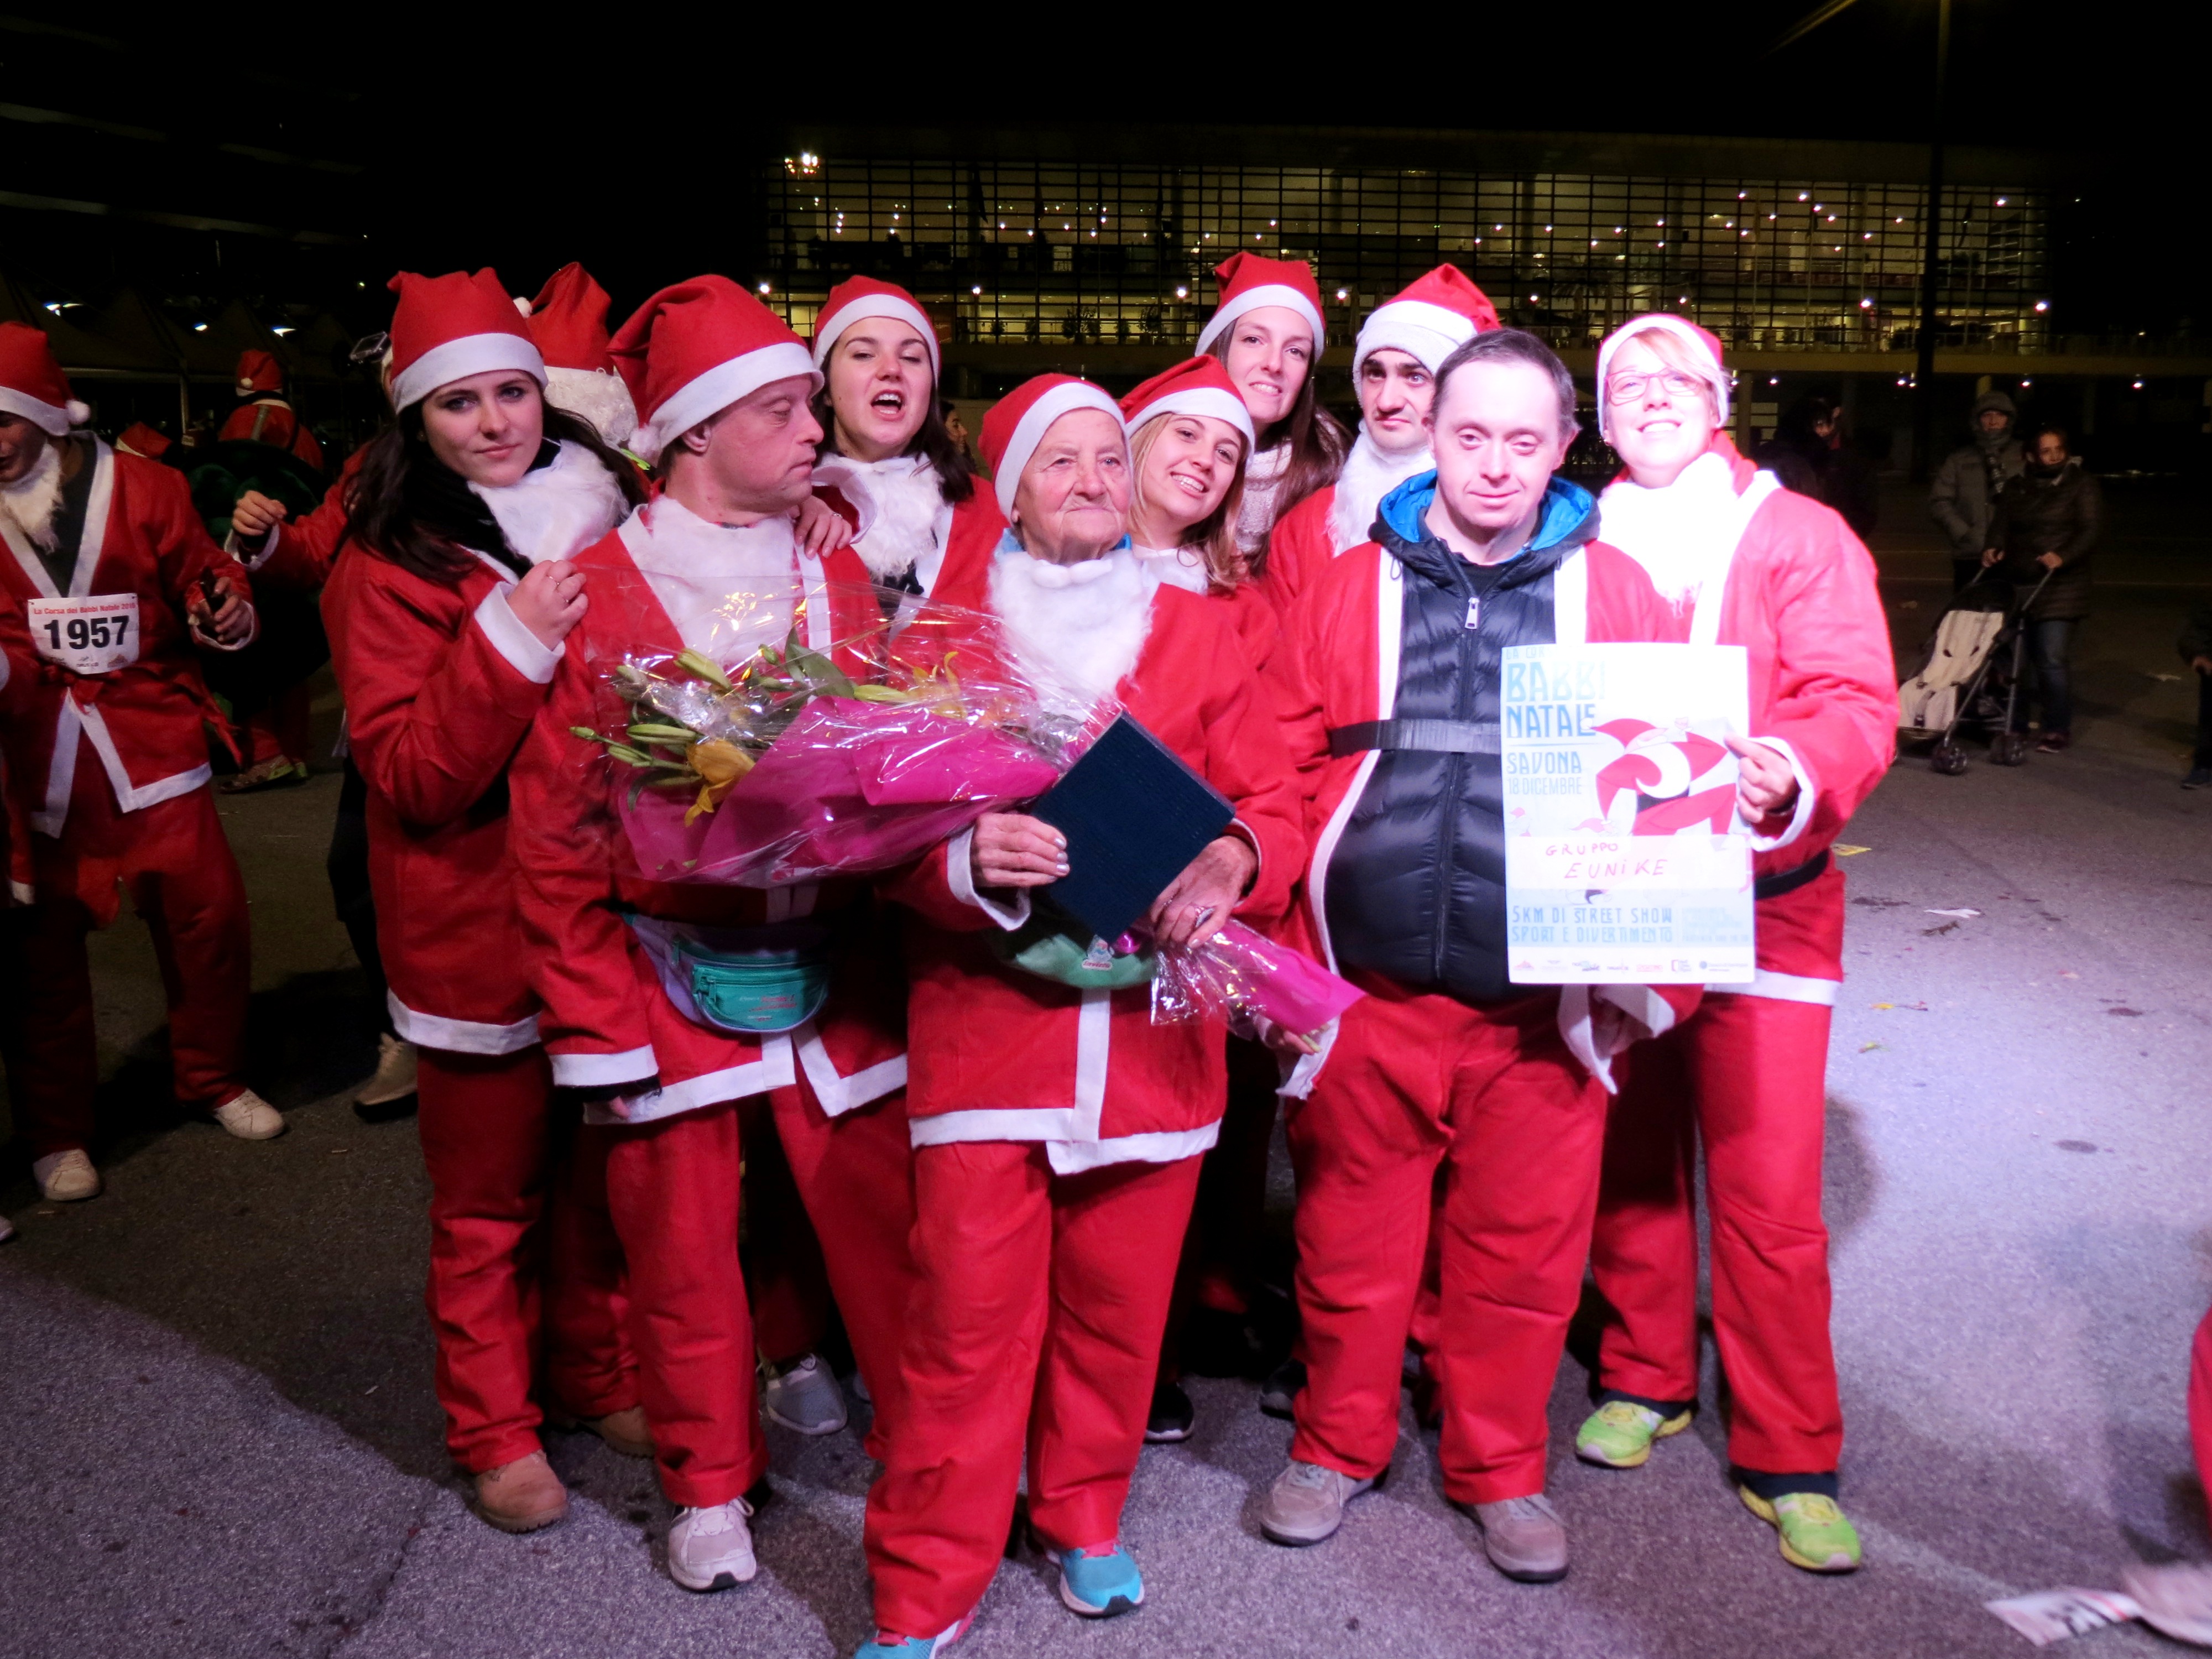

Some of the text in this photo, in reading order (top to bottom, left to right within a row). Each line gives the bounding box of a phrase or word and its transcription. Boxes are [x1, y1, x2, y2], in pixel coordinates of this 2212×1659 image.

[44, 615, 130, 650] 1957
[1506, 661, 1605, 702] BABBI
[1506, 703, 1597, 738] NATALE
[1506, 751, 1582, 775] SAVONA
[1508, 777, 1582, 795] 18 DICEMBRE
[1545, 842, 1619, 857] GRUPPO
[1512, 905, 1544, 924] 5KM
[1552, 907, 1566, 924] DI
[1574, 907, 1622, 924] STREET
[1631, 907, 1673, 924] SHOW
[1512, 926, 1554, 943] SPORT
[1563, 926, 1569, 942] E
